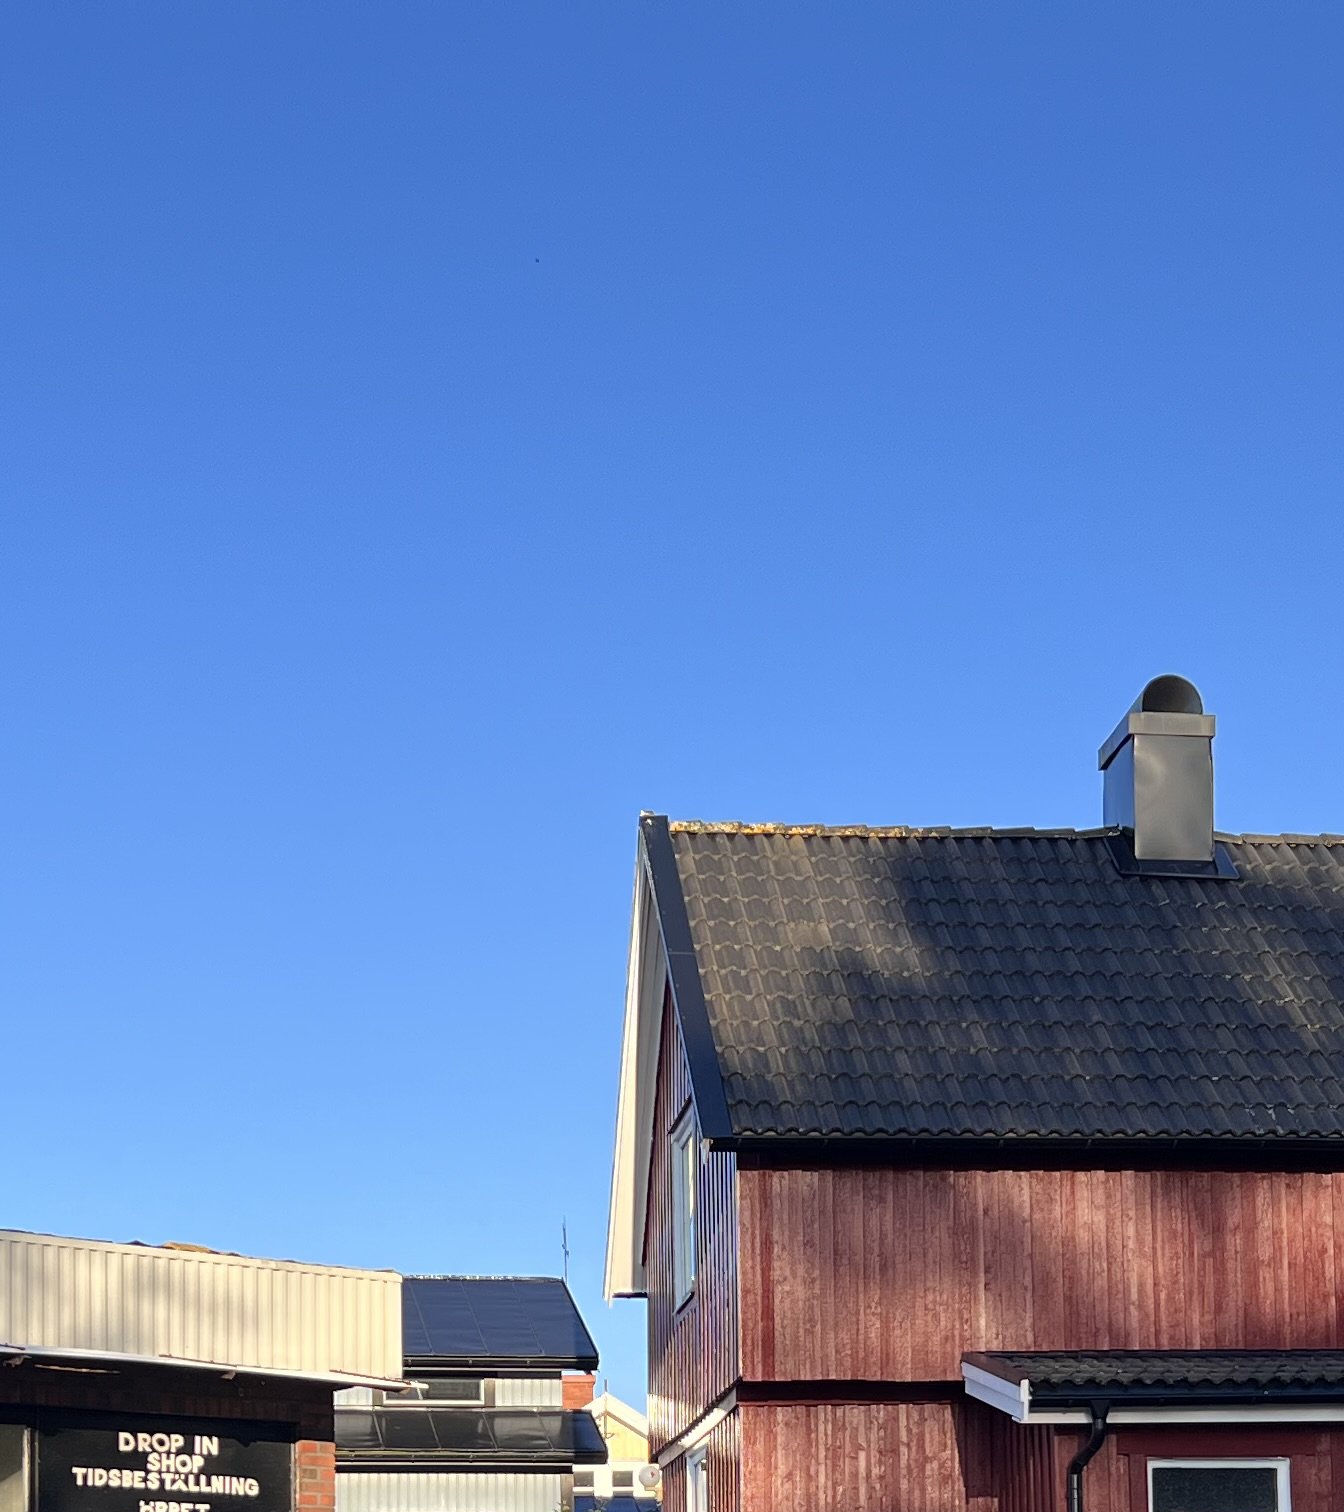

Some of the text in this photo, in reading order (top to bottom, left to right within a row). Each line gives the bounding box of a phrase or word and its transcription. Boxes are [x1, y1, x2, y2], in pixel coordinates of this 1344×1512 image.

[118, 1432, 219, 1455] DROP IN
[147, 1452, 204, 1473] SHOP
[72, 1467, 259, 1495] TIDSBESTÄLLNING
